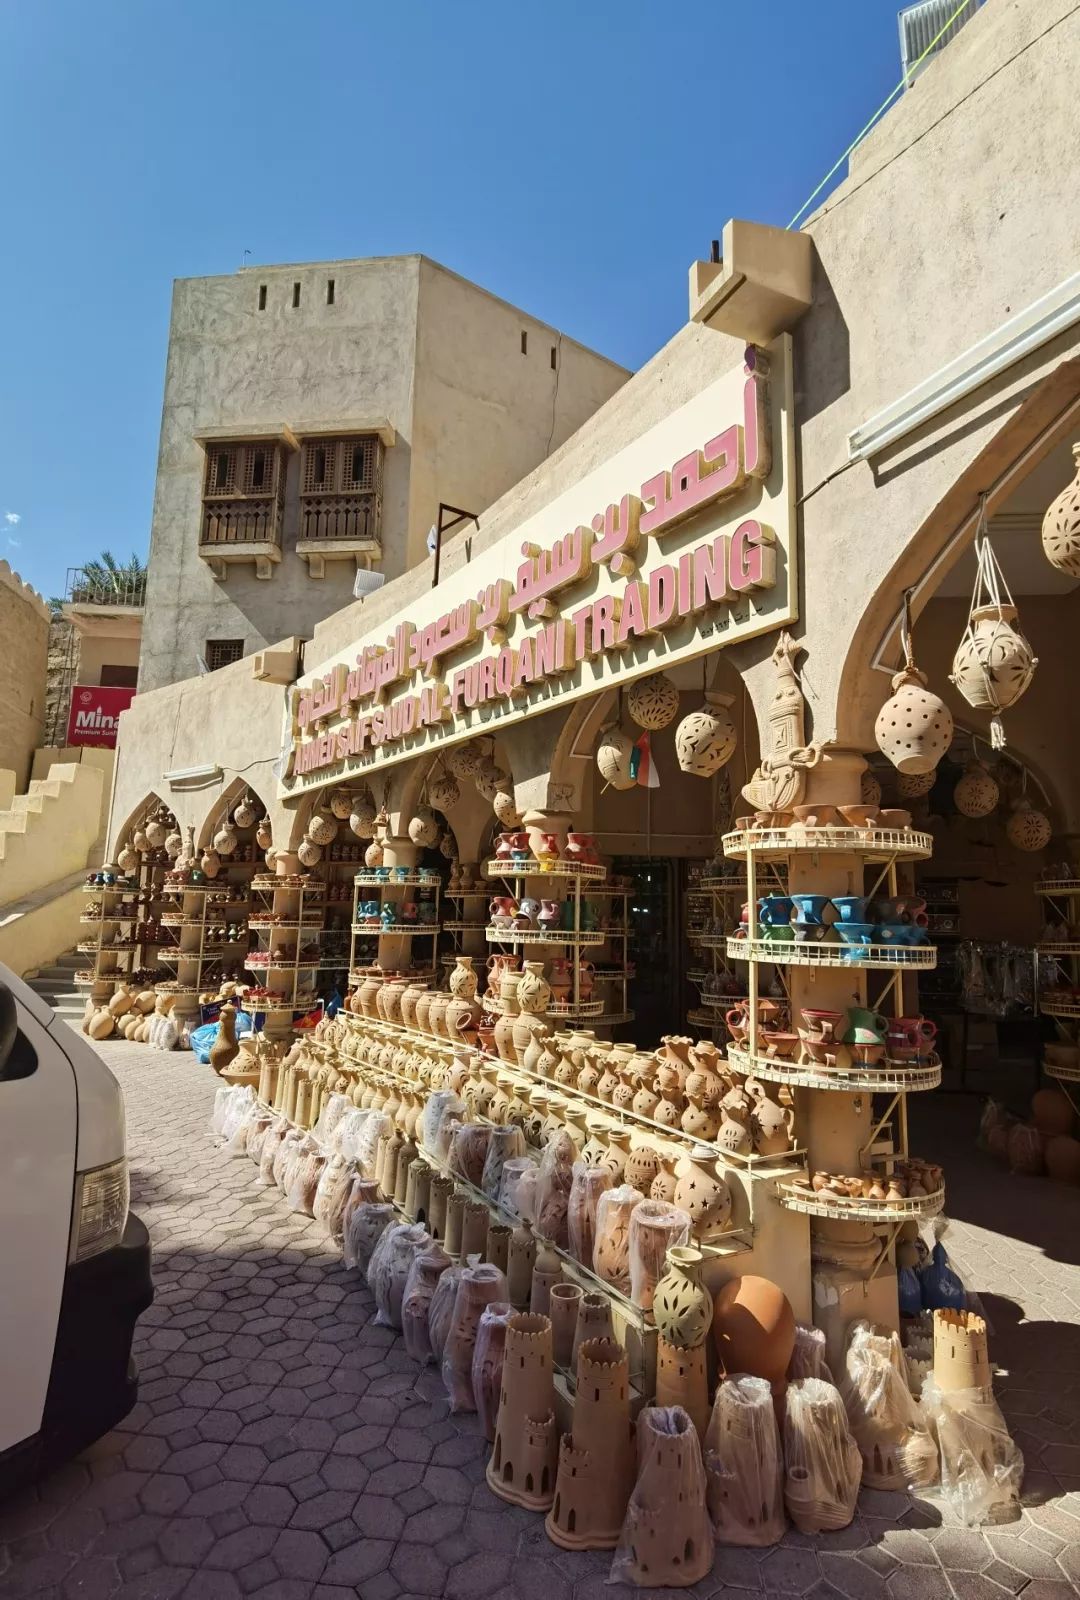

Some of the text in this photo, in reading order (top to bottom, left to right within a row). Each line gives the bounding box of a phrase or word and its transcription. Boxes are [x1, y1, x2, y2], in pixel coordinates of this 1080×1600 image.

[639, 345, 758, 534] أحمد
[508, 526, 583, 619] سيف
[591, 494, 629, 573] بن
[293, 732, 336, 776] AHMED
[337, 716, 371, 759] SAIF
[371, 695, 415, 746] SAUD
[572, 519, 763, 661] TRADING
[409, 599, 473, 678] سعود
[476, 578, 503, 640] بن
